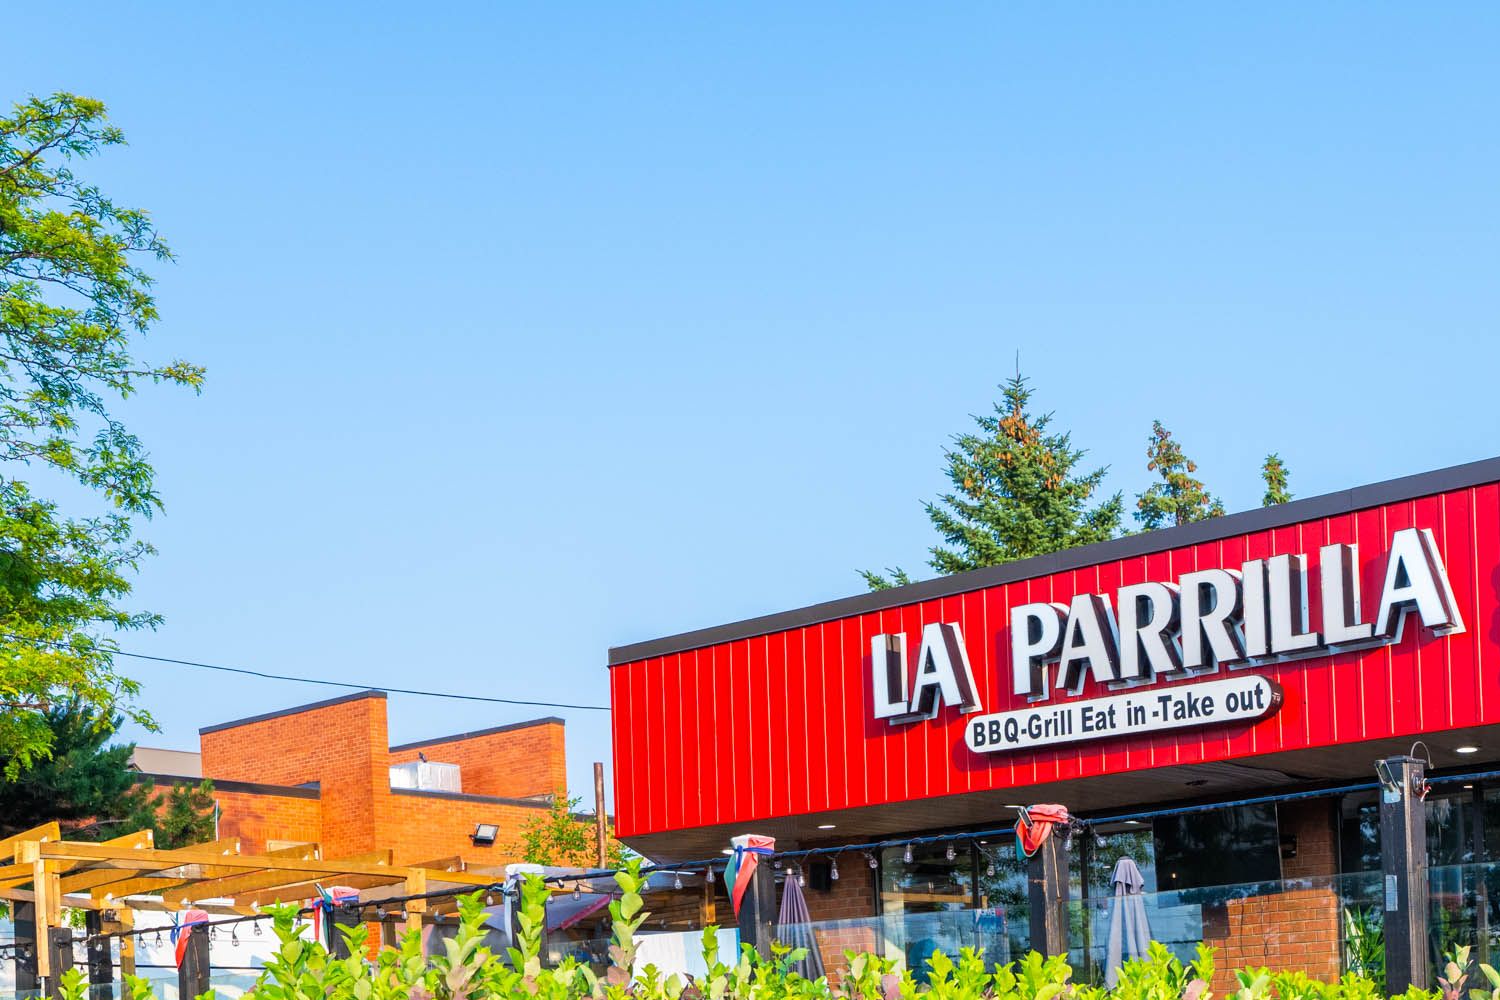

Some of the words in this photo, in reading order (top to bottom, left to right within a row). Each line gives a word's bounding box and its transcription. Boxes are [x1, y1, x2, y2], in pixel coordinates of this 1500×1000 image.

[871, 622, 978, 724] LA
[1011, 528, 1463, 702] PARRILLA
[973, 709, 1072, 747] BBQ-Grill
[1081, 703, 1116, 733] Eat
[1127, 700, 1146, 727] in
[1226, 681, 1264, 713] out
